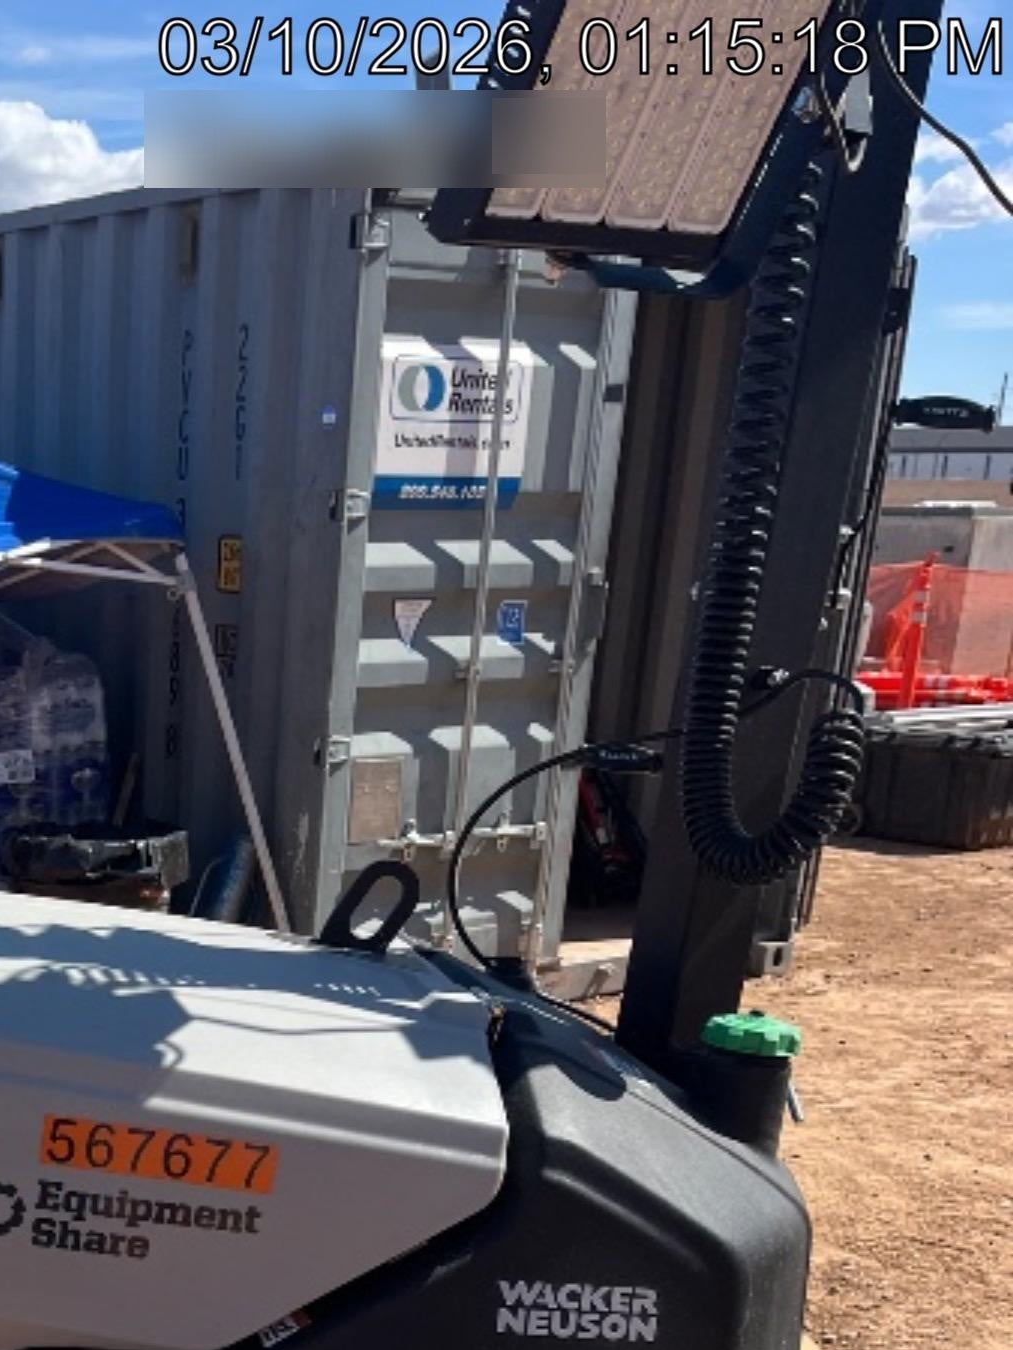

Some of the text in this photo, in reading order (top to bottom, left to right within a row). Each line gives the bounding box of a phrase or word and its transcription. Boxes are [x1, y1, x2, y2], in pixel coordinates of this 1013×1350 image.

[45, 1118, 271, 1188] 567677
[34, 1178, 262, 1233] Equipment
[31, 1217, 150, 1259] Share
[498, 1279, 658, 1315] WACKER
[496, 1307, 658, 1342] NEUSON
